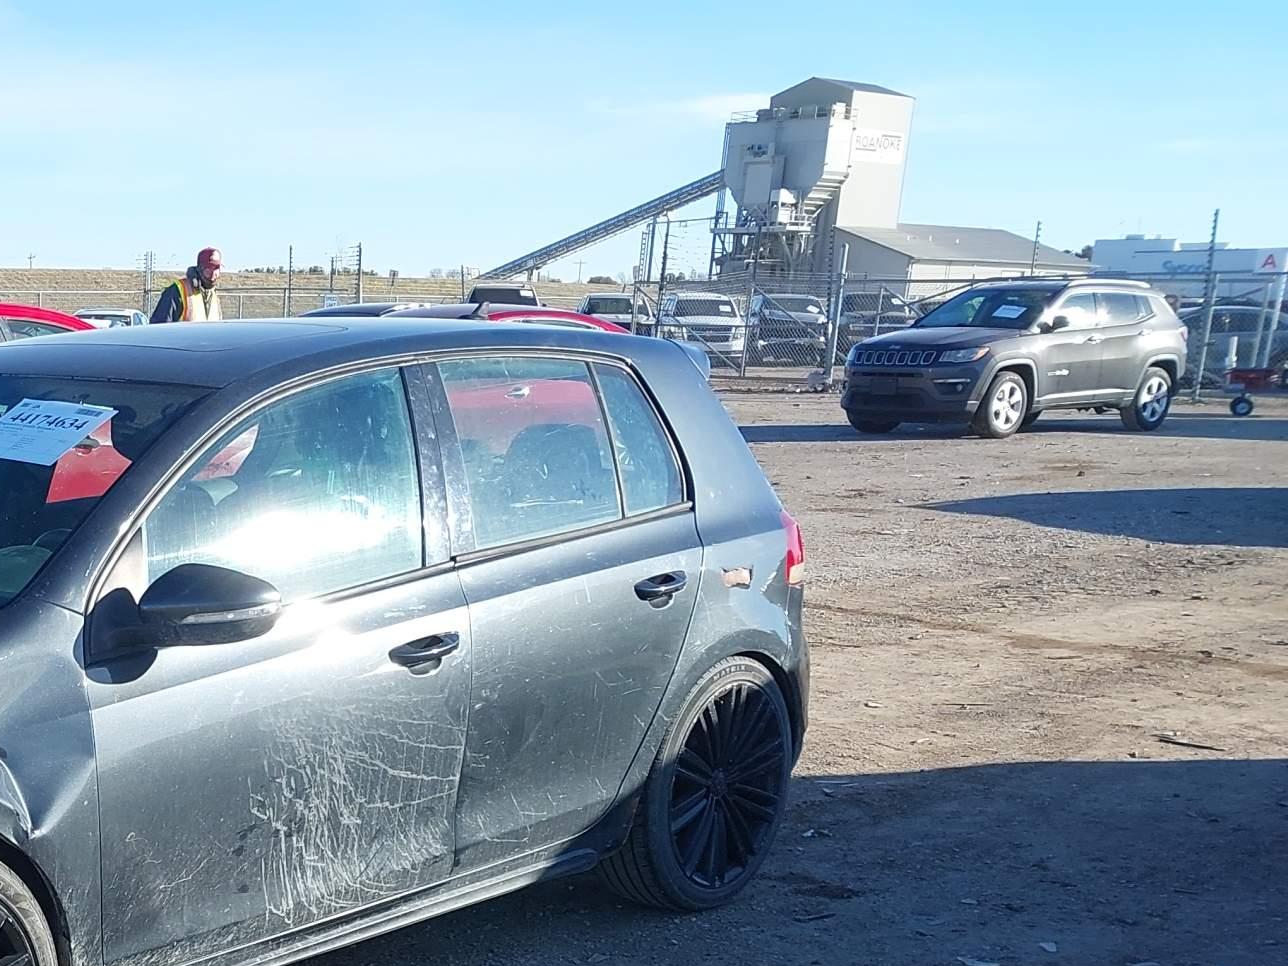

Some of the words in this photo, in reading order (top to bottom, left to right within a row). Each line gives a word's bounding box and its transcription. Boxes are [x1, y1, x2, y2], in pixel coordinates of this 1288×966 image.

[855, 134, 902, 152] ROANOKE
[1261, 253, 1277, 268] A
[10, 412, 90, 431] 44174634
